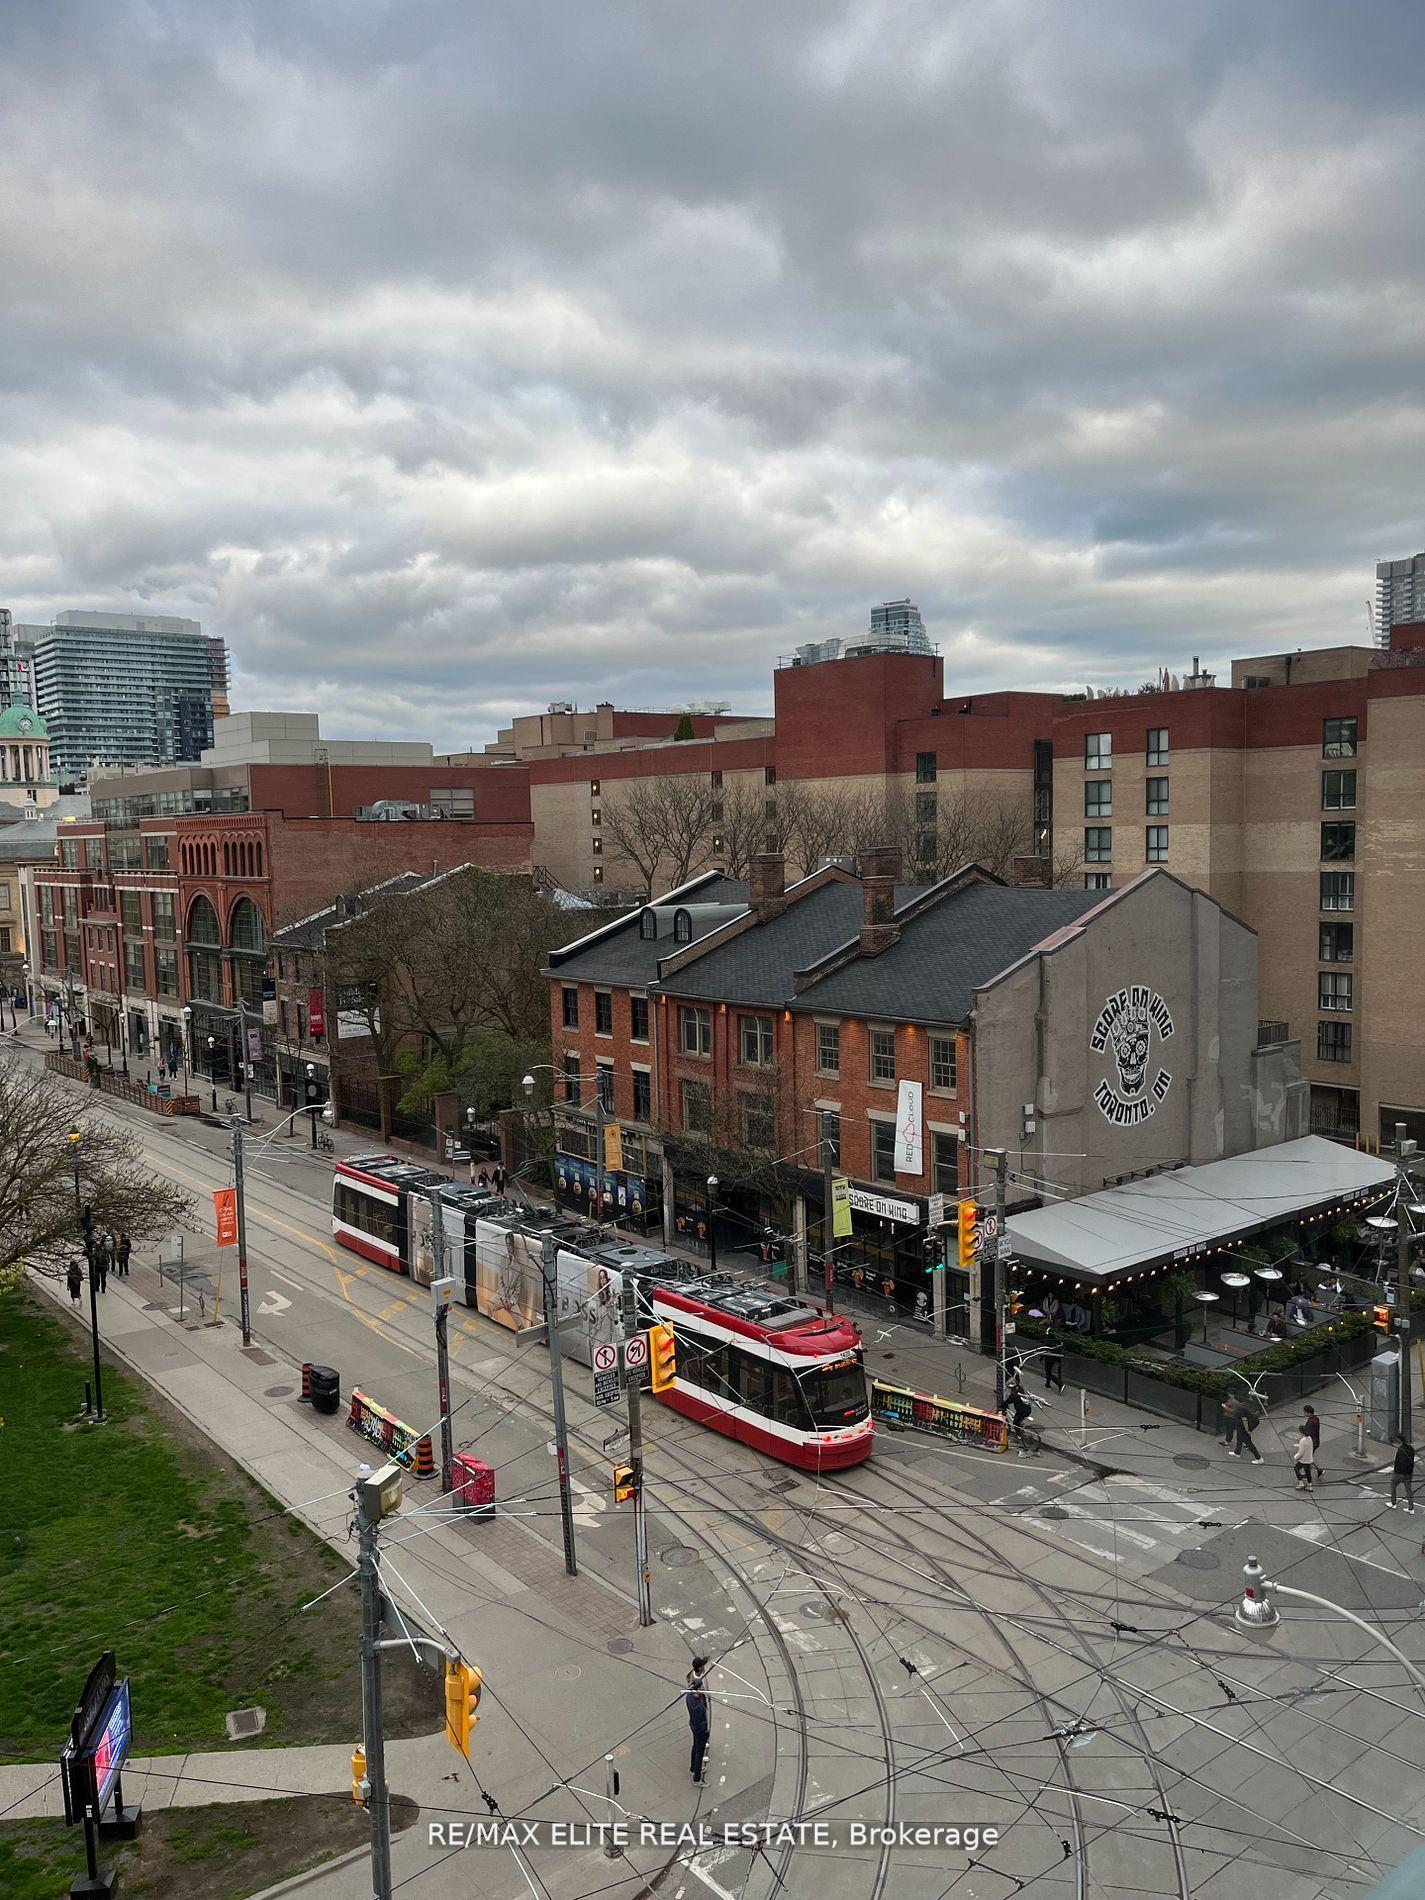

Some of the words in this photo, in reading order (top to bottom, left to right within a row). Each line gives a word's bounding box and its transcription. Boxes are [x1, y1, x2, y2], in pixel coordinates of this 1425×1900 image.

[1090, 988, 1129, 1053] SCORE
[1131, 985, 1150, 1007] ON
[1149, 992, 1174, 1041] KING
[907, 1091, 915, 1123] CLOUD
[1093, 1078, 1155, 1126] TORONTO,
[1152, 1068, 1172, 1102] ON
[905, 1143, 914, 1163] RED
[876, 1200, 887, 1214] ON
[889, 1203, 908, 1220] KING
